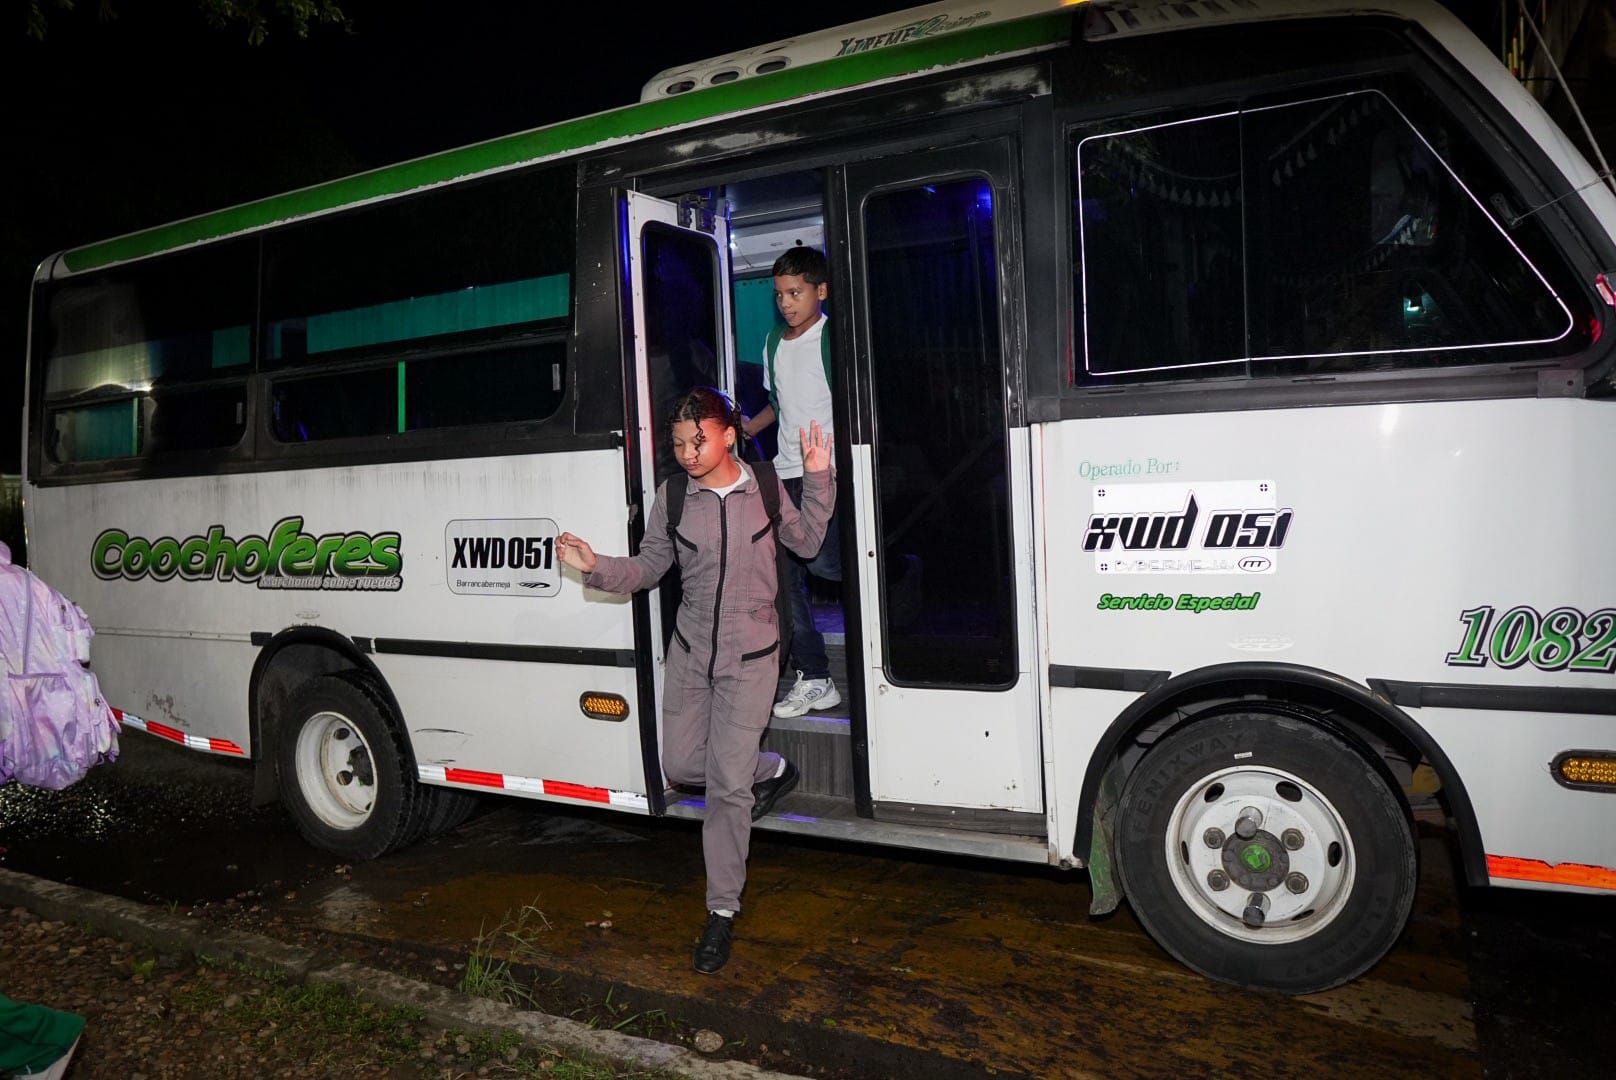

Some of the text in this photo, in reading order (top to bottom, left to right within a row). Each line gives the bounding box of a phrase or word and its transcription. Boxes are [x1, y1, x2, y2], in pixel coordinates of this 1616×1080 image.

[1079, 459, 1141, 481] Operado
[91, 515, 403, 582] Coochoferes
[322, 575, 356, 589] sobre
[356, 575, 401, 590] ruedas
[456, 580, 511, 590] Barrancabermeja
[1097, 592, 1261, 613] Servicio Especial
[1445, 605, 1616, 674] 1082
